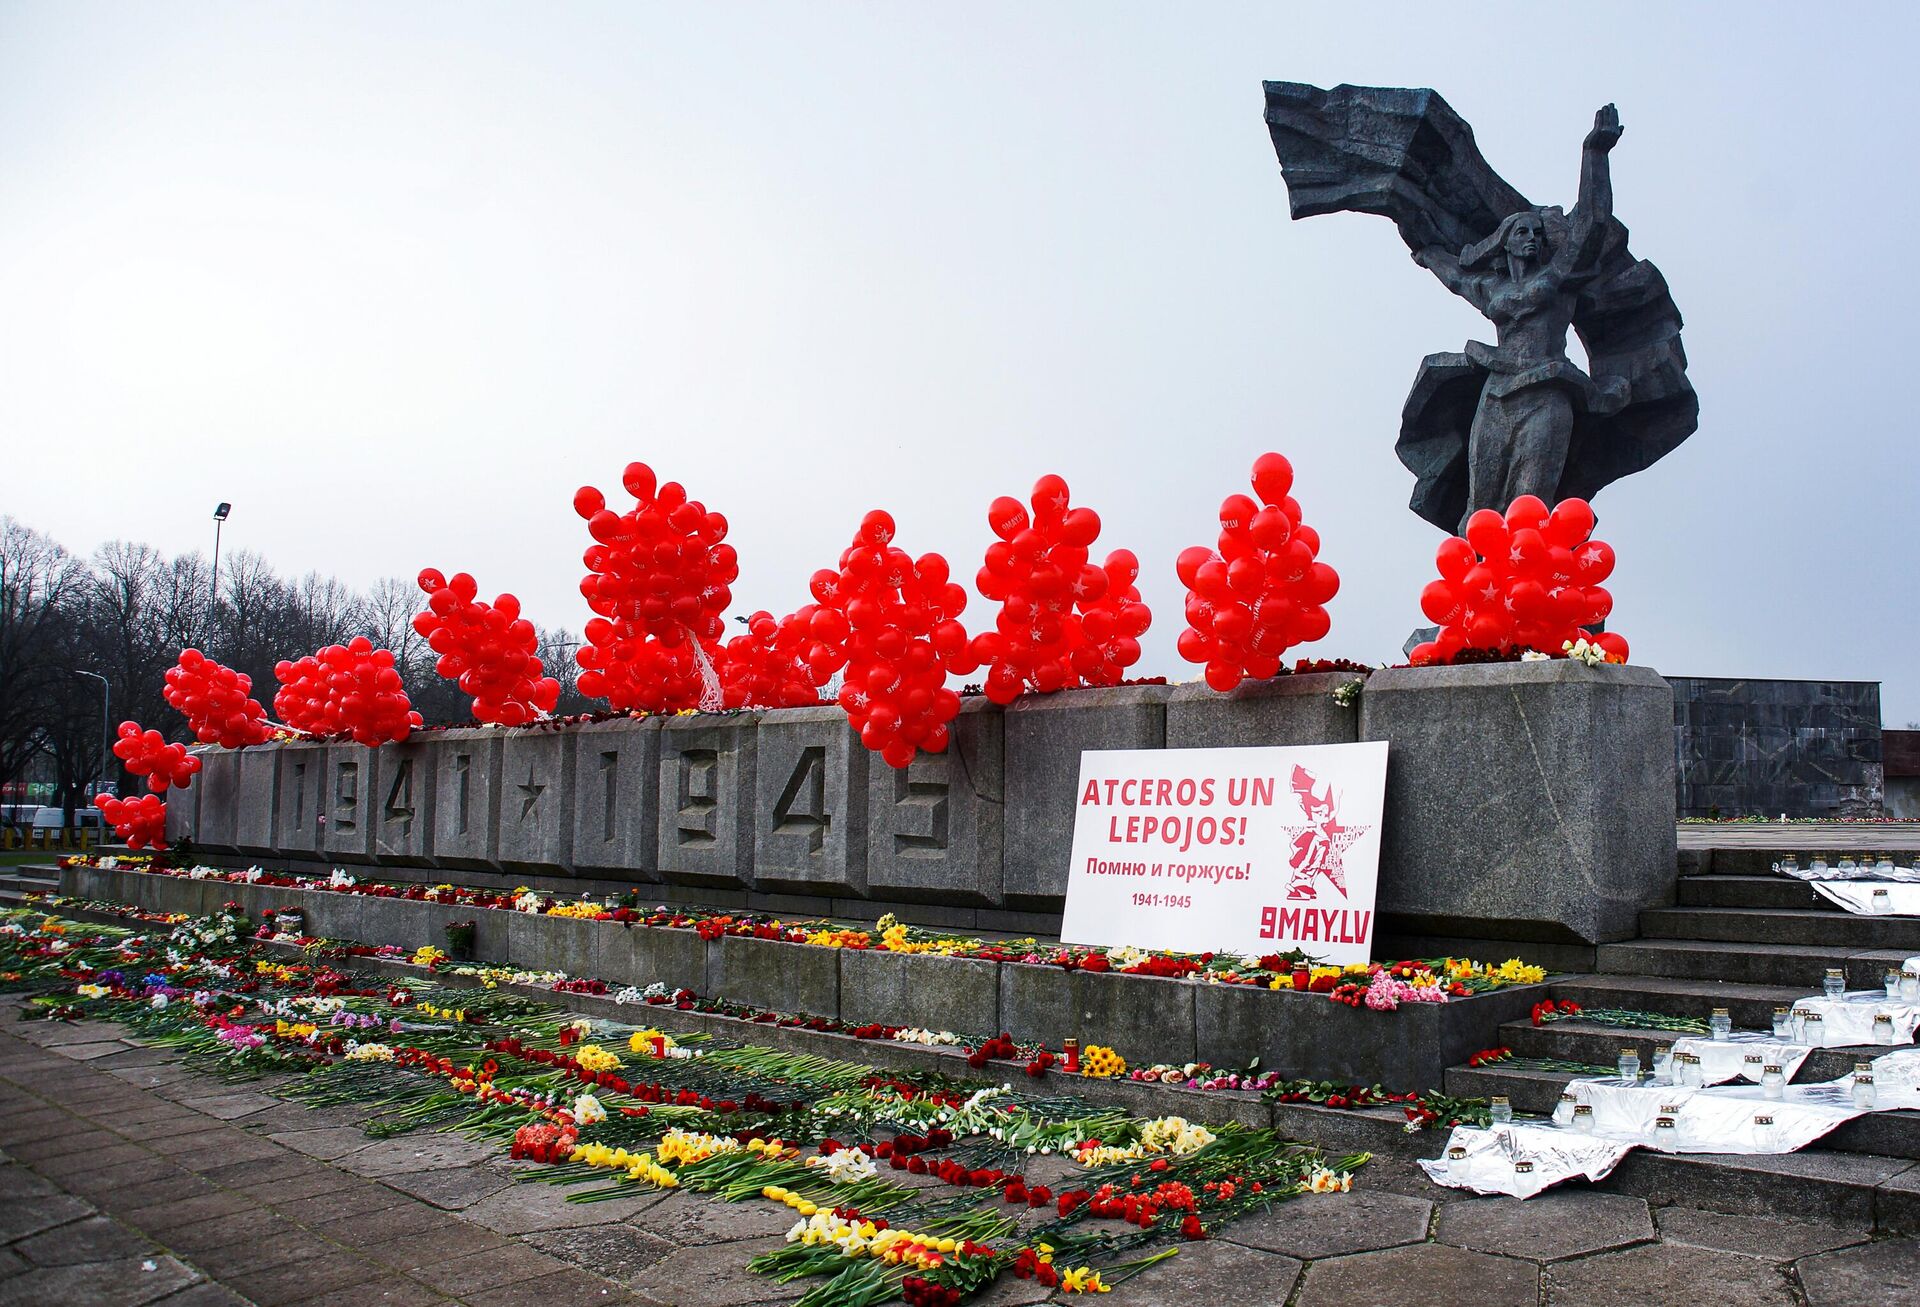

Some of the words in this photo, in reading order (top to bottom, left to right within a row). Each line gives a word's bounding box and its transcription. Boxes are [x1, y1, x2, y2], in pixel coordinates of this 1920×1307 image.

[295, 754, 470, 838] 1941
[1081, 778, 1215, 807] ATCEROS
[1227, 777, 1275, 807] UN
[1108, 815, 1247, 852] LEPOJOS!
[1086, 857, 1147, 877] Помню
[1150, 863, 1162, 877] и
[1167, 862, 1251, 885] горжусь!
[1131, 892, 1192, 909] 1941-1945
[1259, 906, 1371, 945] 9MAY.LV
